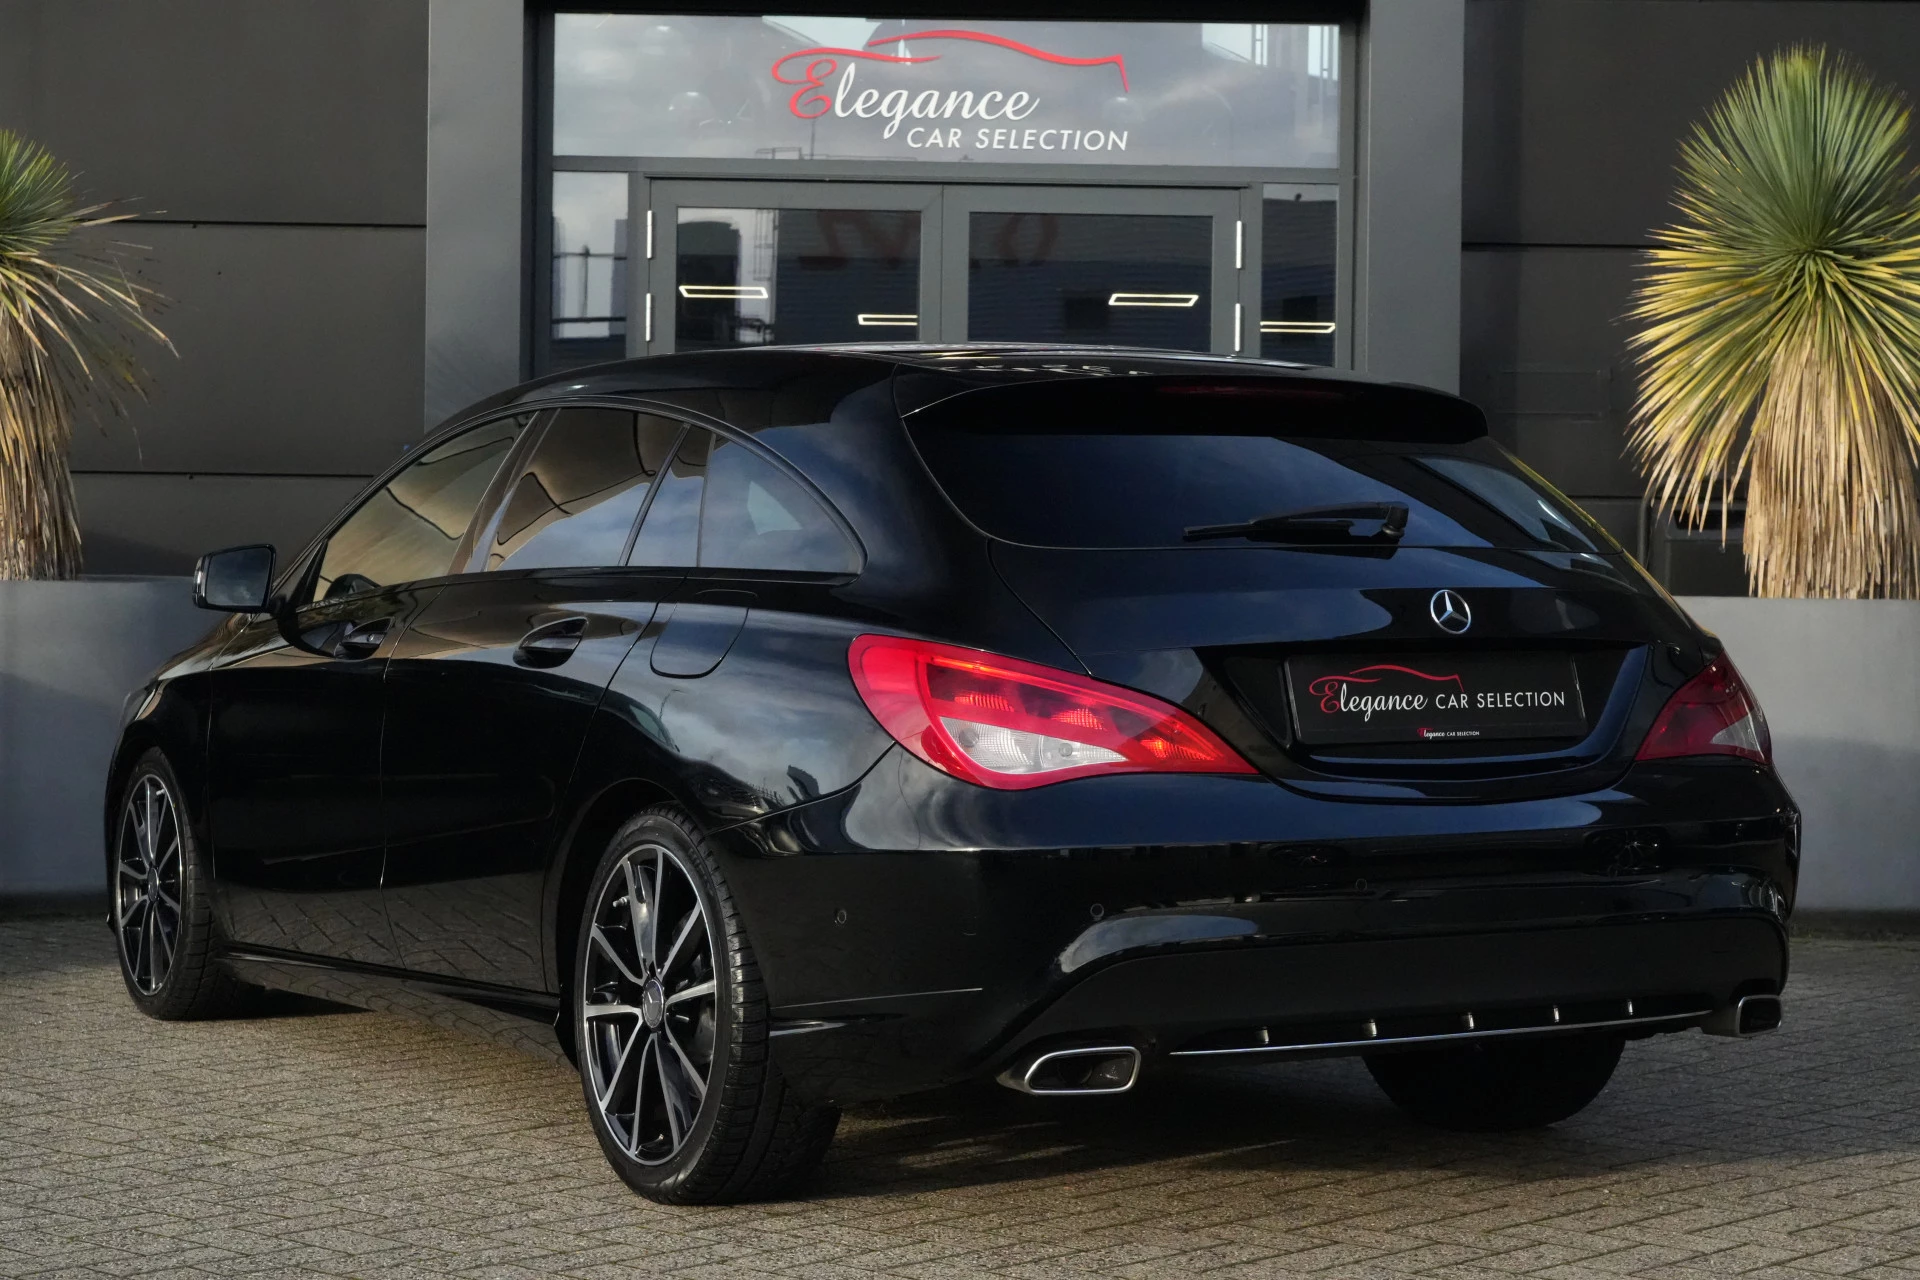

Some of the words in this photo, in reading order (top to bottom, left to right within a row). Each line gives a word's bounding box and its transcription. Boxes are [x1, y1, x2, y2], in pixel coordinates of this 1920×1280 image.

[772, 57, 1040, 140] Elegance
[906, 127, 961, 149] CAR
[974, 128, 1129, 151] SELECTION
[1309, 678, 1428, 722] Elegance
[1435, 693, 1469, 709] CAR
[1476, 691, 1566, 708] SELECTION
